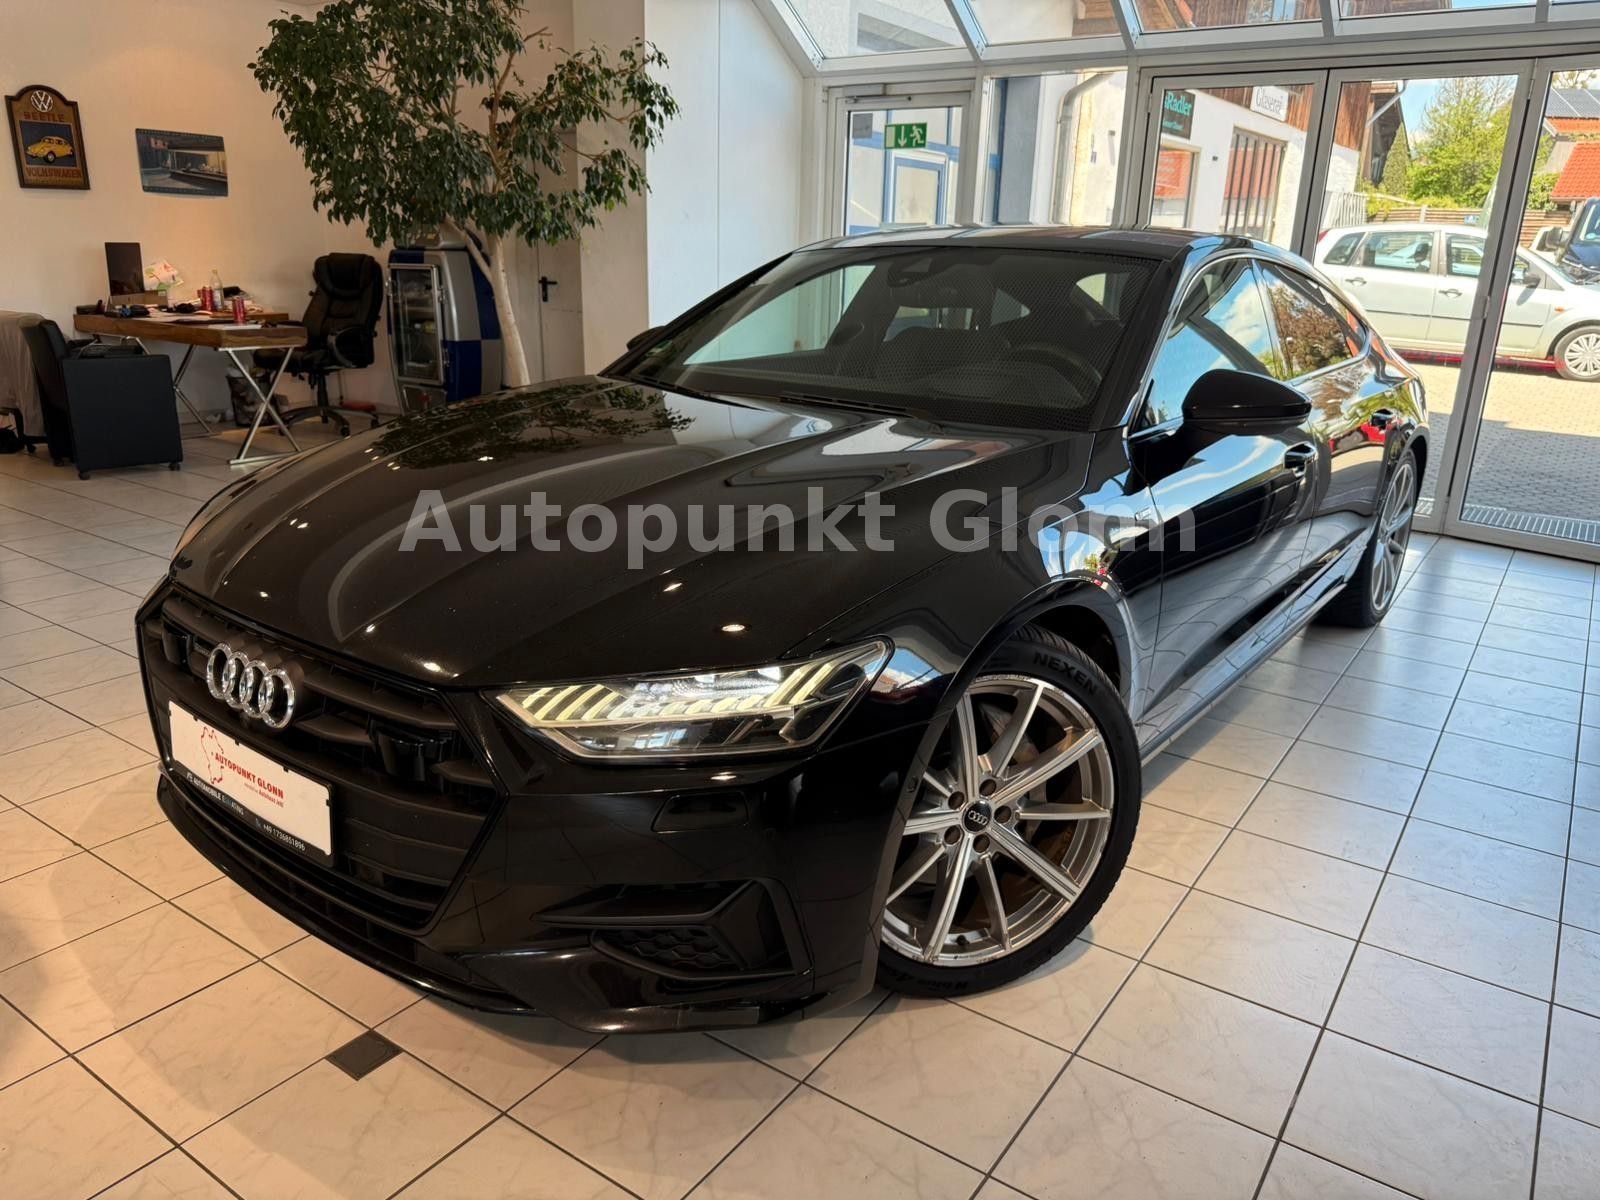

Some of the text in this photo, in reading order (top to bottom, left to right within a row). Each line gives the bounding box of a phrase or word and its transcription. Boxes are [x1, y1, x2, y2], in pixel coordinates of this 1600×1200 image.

[24, 112, 65, 122] BEETLE
[25, 167, 82, 178] VOLKSWAGEN
[1034, 652, 1097, 696] NEXEN
[215, 752, 256, 783] AUTOPUNKT
[257, 777, 284, 799] GLONN
